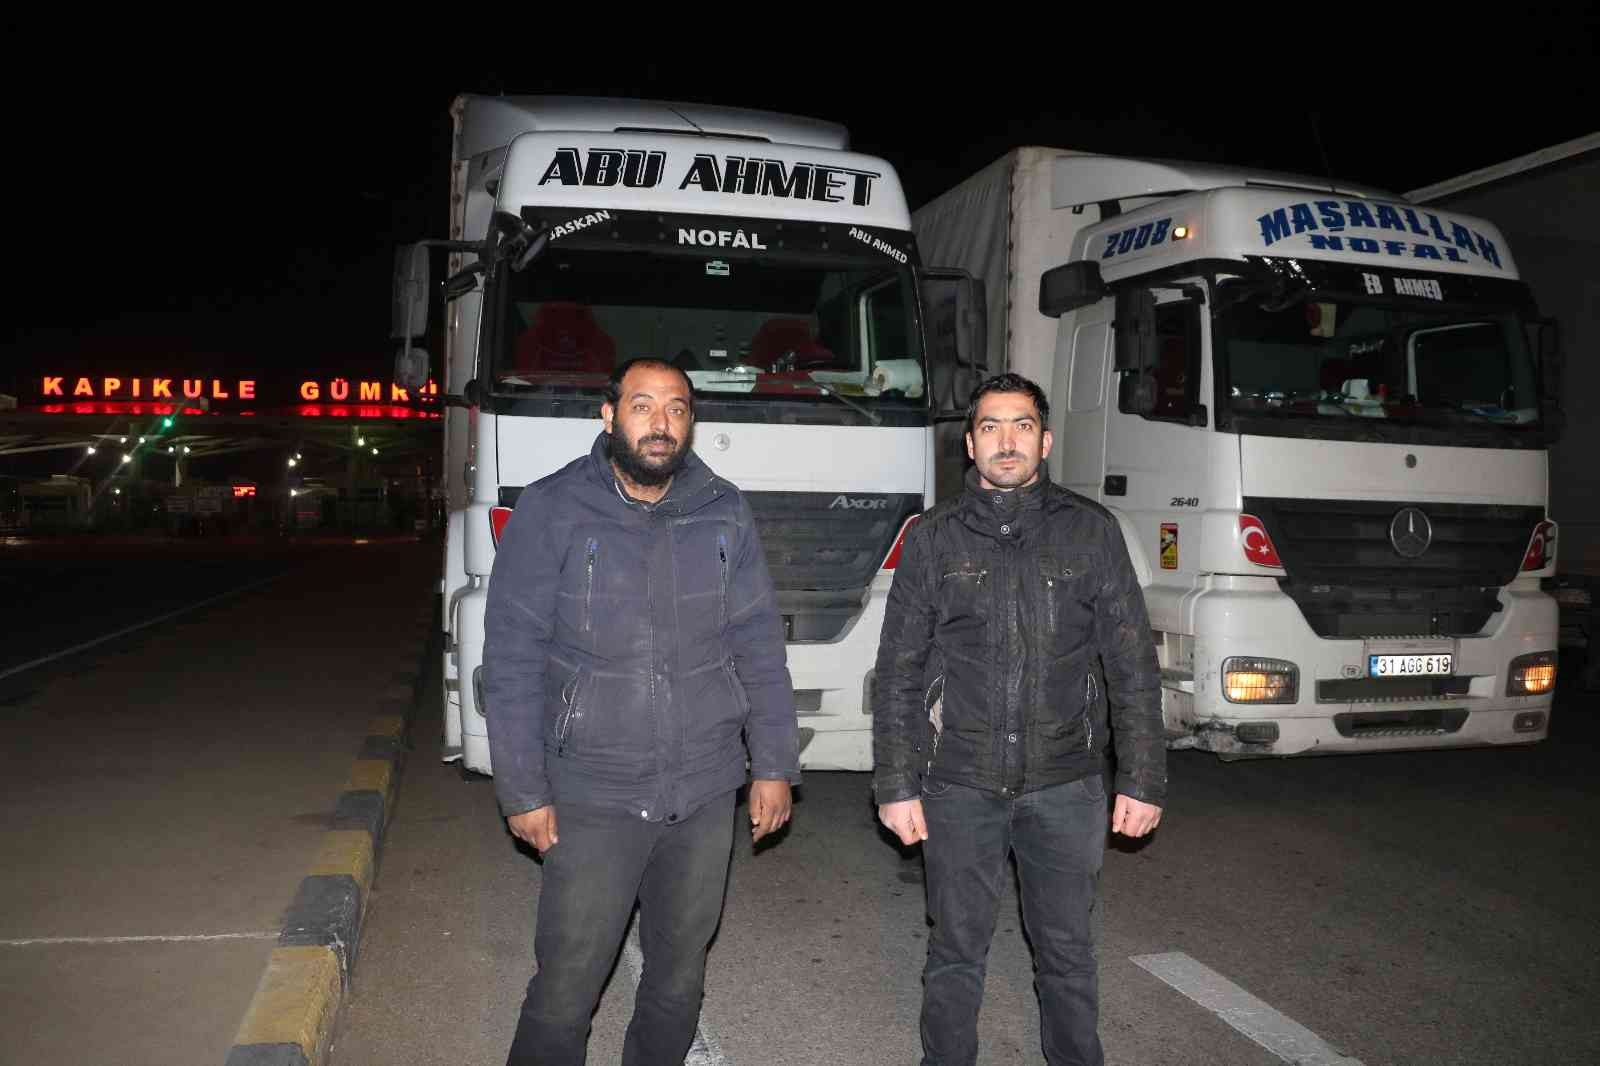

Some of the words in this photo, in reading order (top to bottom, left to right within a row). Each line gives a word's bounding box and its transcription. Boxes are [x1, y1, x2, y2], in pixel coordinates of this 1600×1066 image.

[538, 147, 666, 188] ABU
[678, 153, 881, 206] AHMET
[678, 228, 767, 250] NOFÂL
[849, 227, 872, 244] ABU
[872, 238, 908, 264] AHMED
[1102, 217, 1172, 259] 2008
[1257, 200, 1503, 269] MAŞAALLAH
[1307, 234, 1469, 263] NOFAL
[1393, 277, 1443, 301] AHMED
[43, 377, 256, 399] KAPIKULE
[1170, 497, 1199, 507] 2640
[1379, 658, 1394, 673] 31
[1400, 659, 1422, 673] AGG
[1427, 657, 1449, 673] 619
